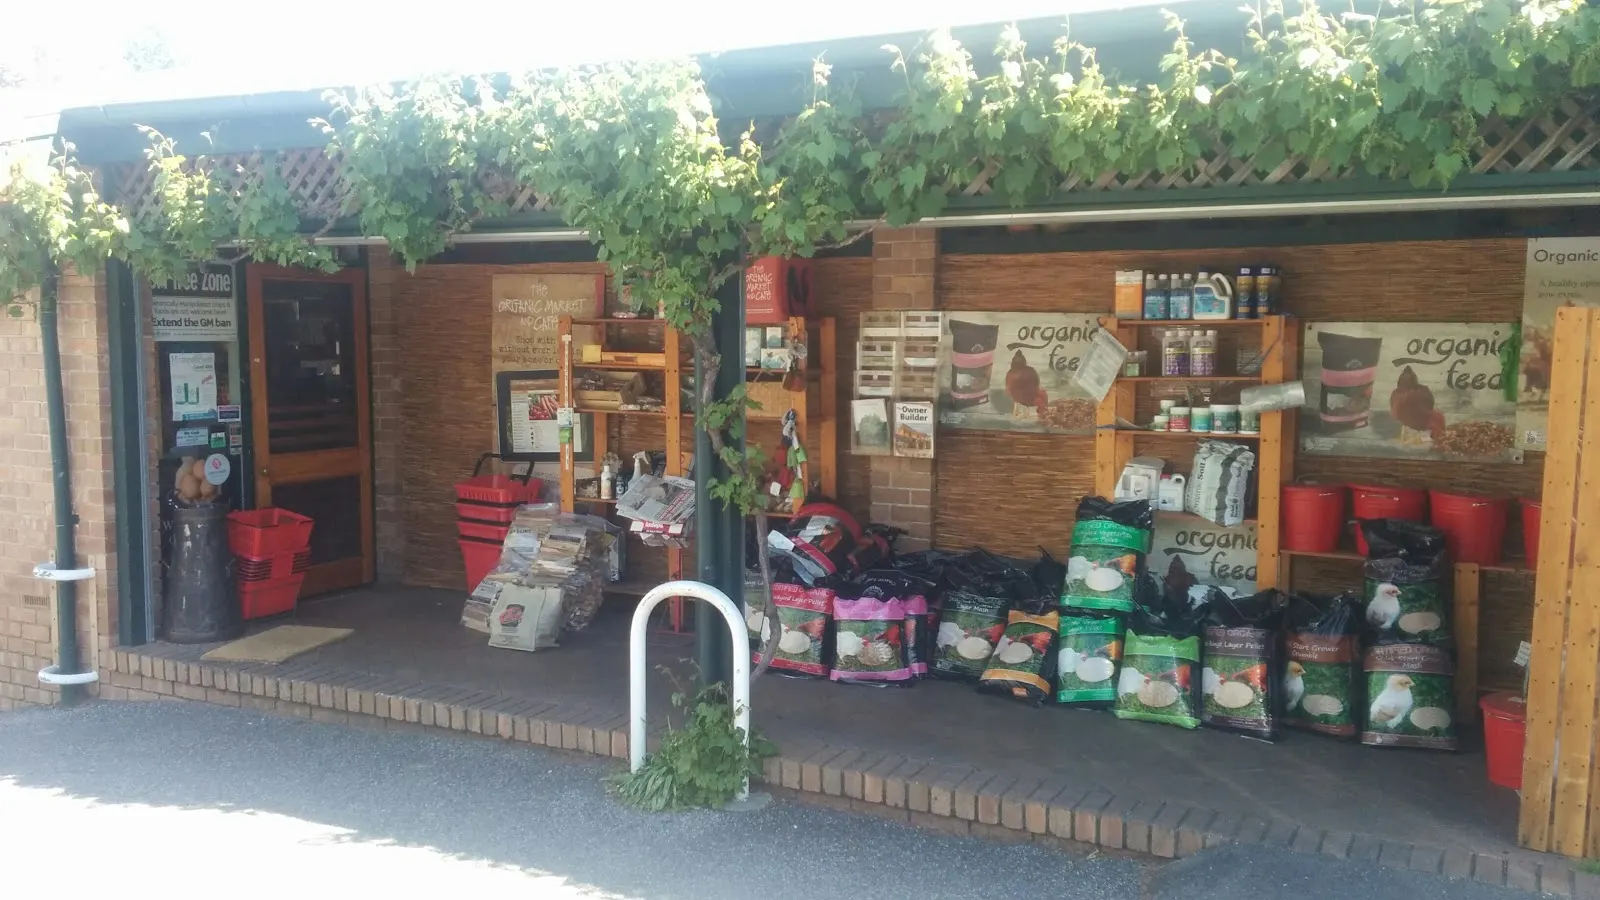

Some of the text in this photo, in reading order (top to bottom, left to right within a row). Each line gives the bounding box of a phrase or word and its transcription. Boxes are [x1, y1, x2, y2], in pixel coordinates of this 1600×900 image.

[1534, 249, 1599, 265] Organic
[202, 272, 231, 292] Zone
[498, 299, 587, 313] ORGANIC MARKET
[152, 317, 232, 328] Extend the GM ban
[1007, 319, 1098, 351] organic
[1049, 344, 1081, 371] fee
[1446, 359, 1506, 391] feed
[902, 406, 928, 415] Owner
[900, 413, 928, 422] Builder
[1224, 641, 1244, 650] Layer
[1245, 642, 1264, 650] Pellet
[1293, 642, 1339, 652] Start Grower
[1292, 650, 1319, 659] Crumble
